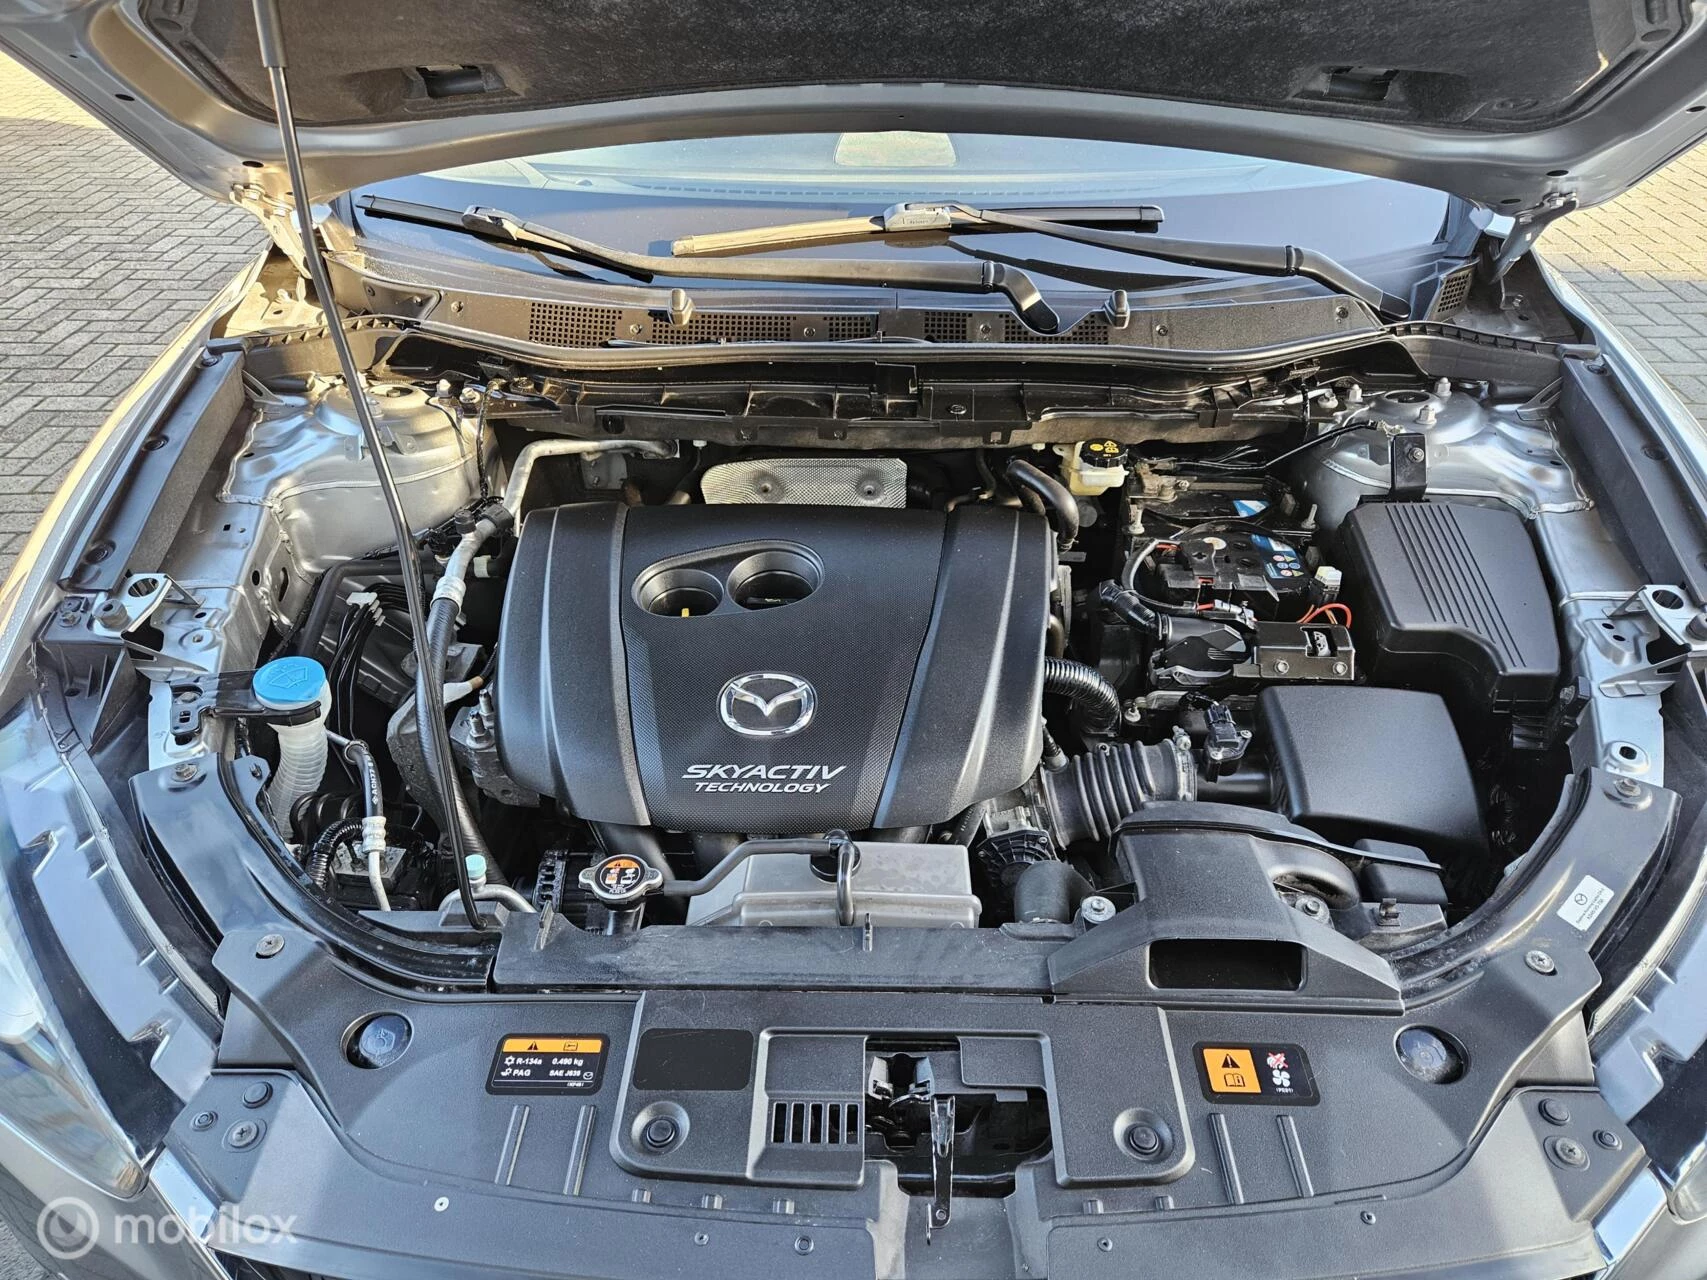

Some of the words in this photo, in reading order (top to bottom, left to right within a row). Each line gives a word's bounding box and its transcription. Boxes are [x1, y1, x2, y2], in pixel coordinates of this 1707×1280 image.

[682, 764, 847, 780] SKYACTIV
[694, 782, 831, 794] TECHNOLOGY
[516, 1057, 542, 1065] R-134a
[573, 1058, 584, 1066] kg
